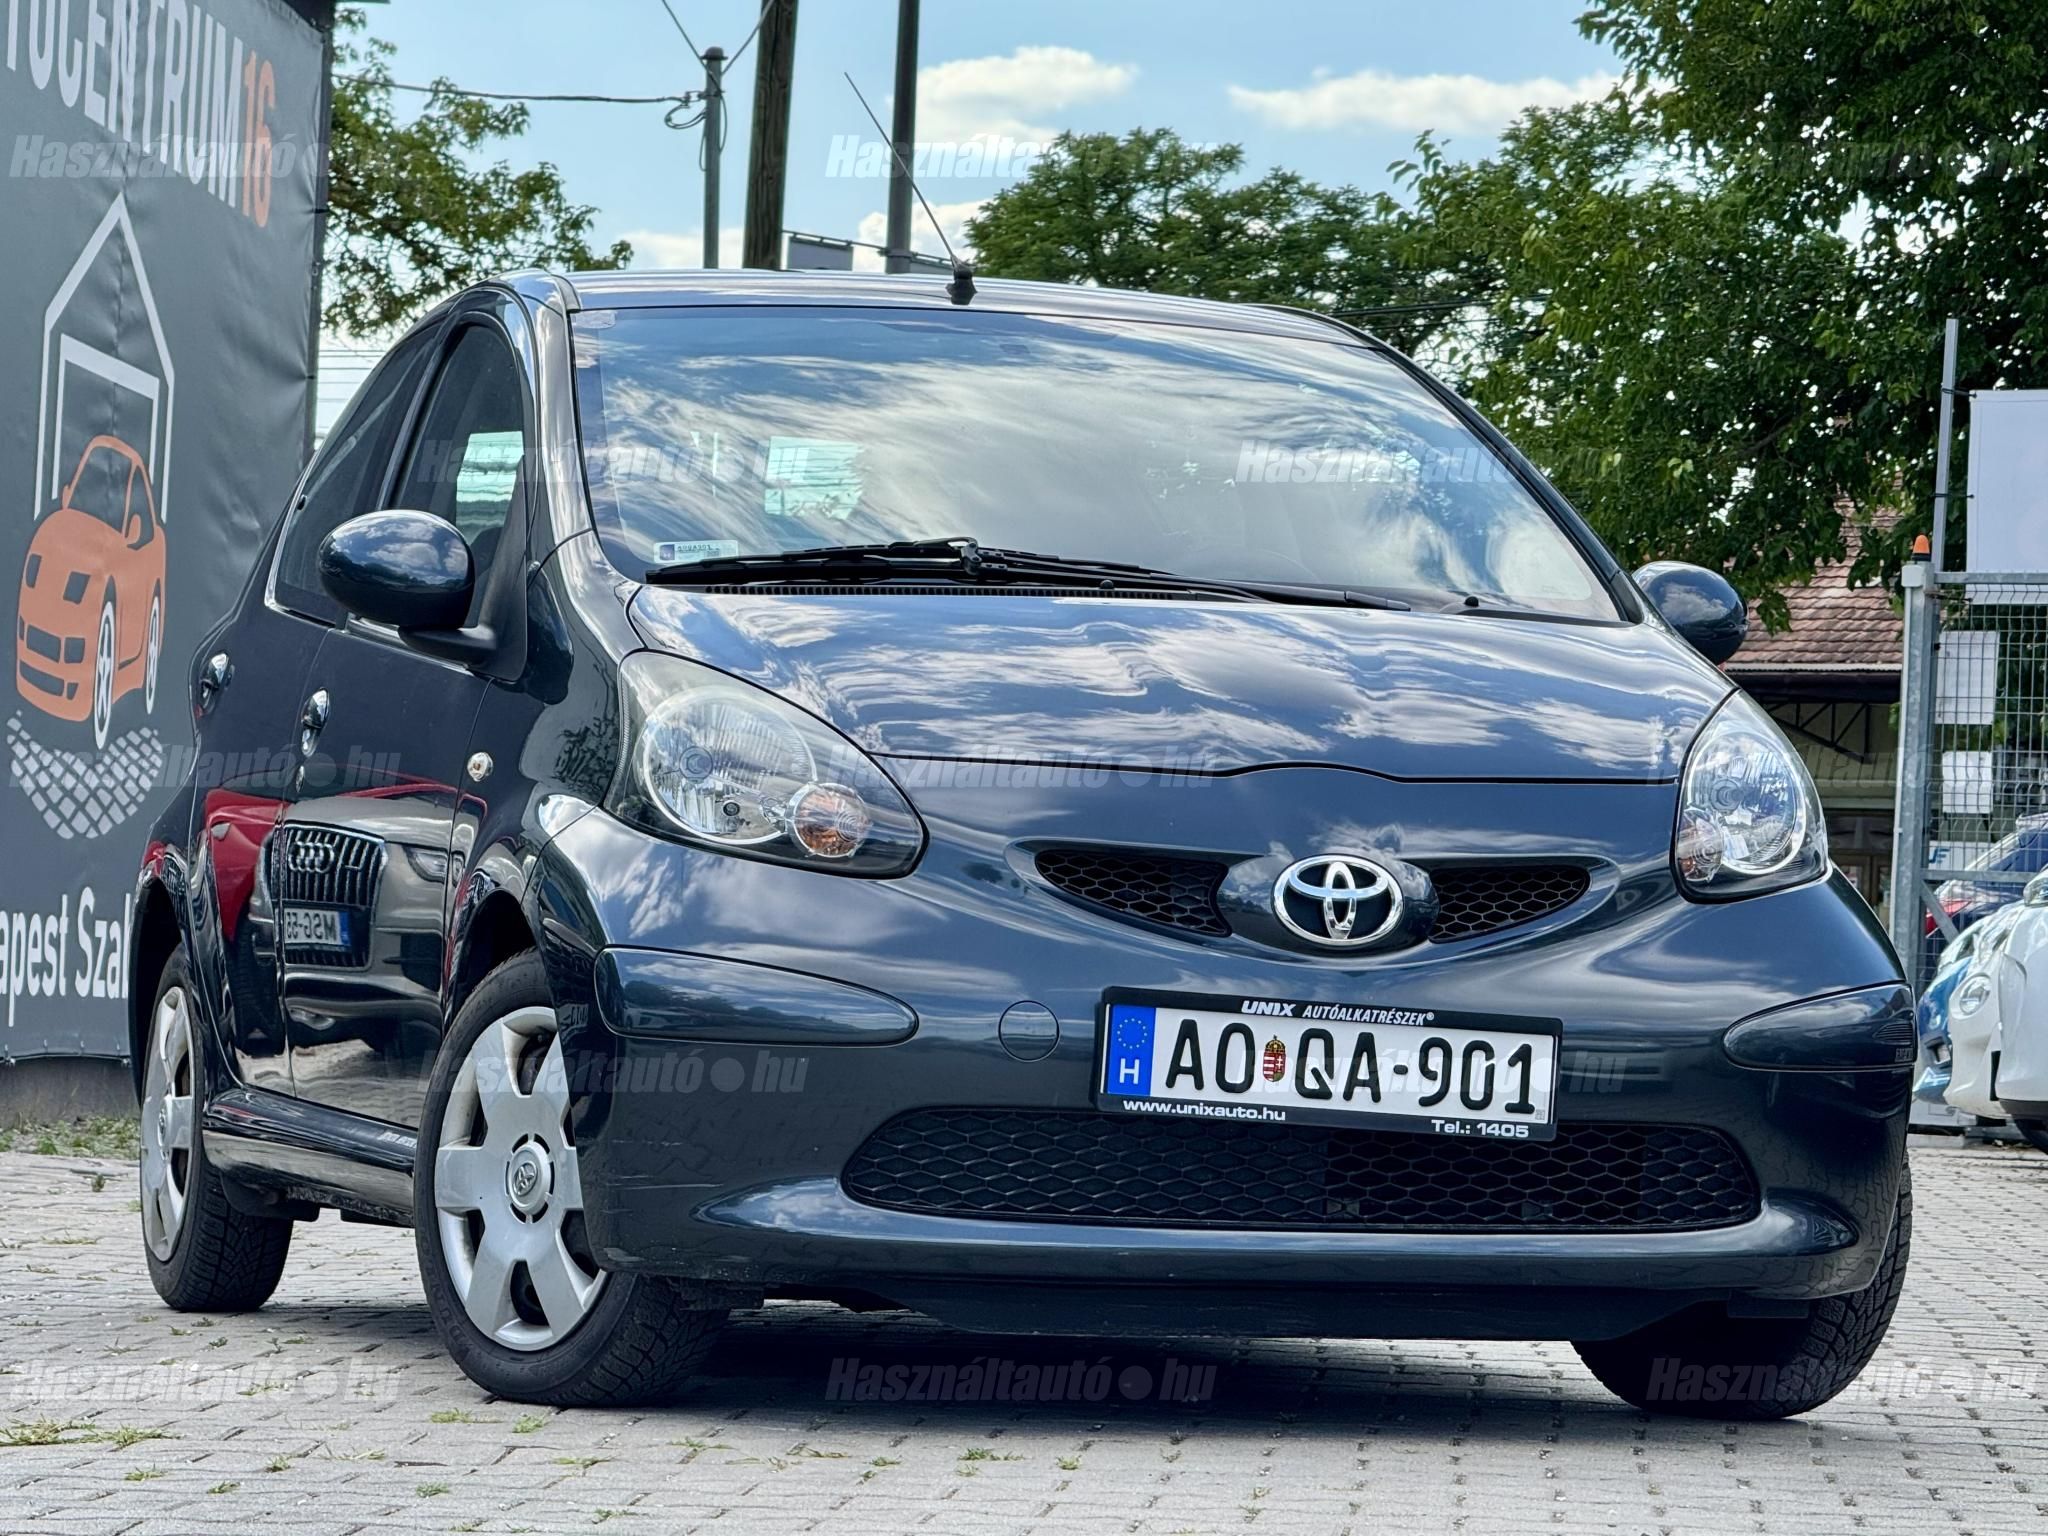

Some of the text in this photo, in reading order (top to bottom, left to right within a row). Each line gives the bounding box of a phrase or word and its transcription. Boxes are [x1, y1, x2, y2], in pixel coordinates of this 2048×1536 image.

[1241, 1000, 1296, 1017] UNIX
[1119, 1057, 1140, 1085] H
[1165, 1018, 1536, 1115] AO QA-901
[1122, 1099, 1287, 1122] www.unixauto.hu
[1430, 1119, 1530, 1138] Tel.: 1405
